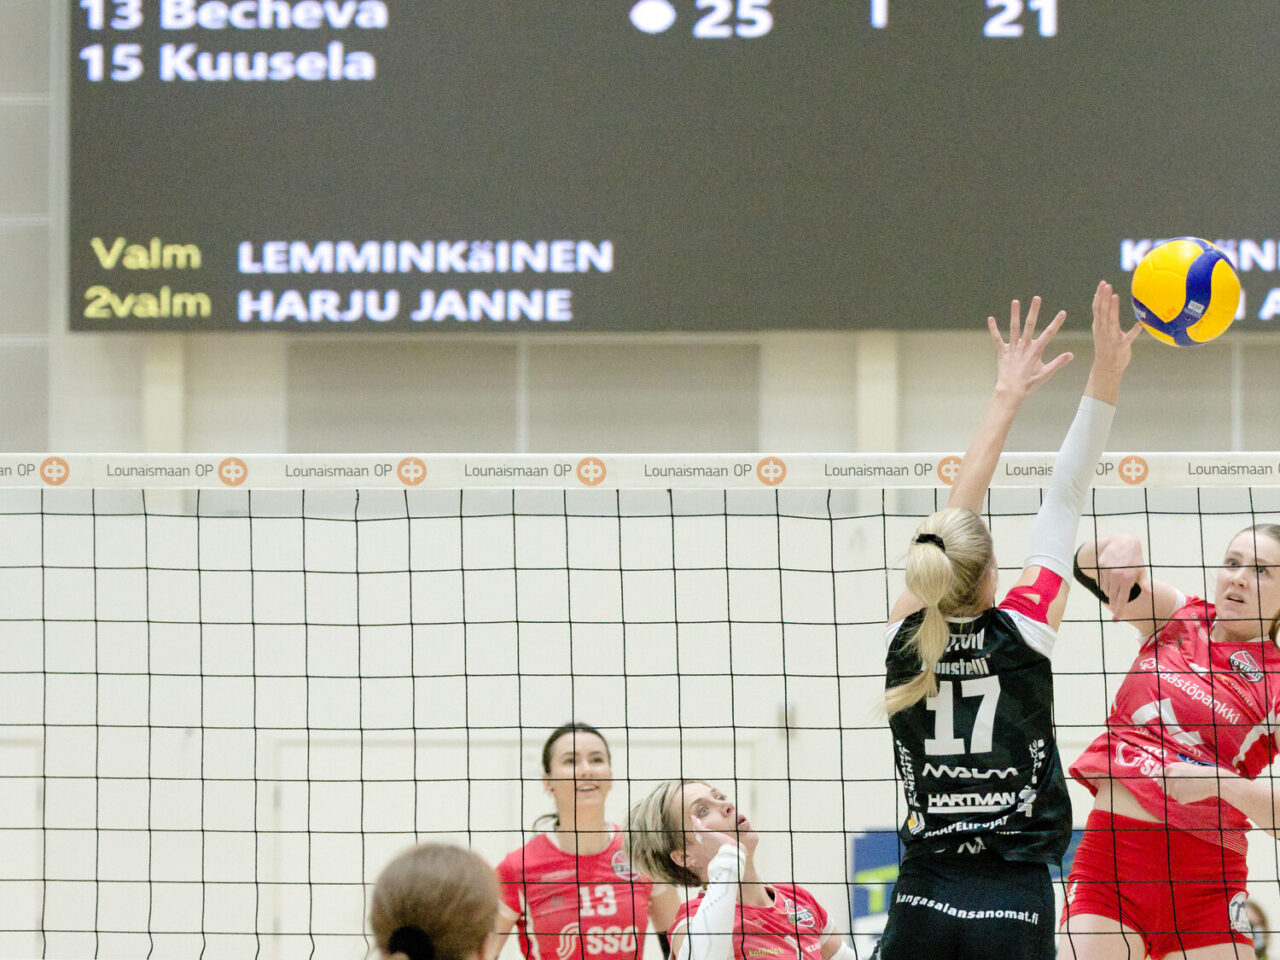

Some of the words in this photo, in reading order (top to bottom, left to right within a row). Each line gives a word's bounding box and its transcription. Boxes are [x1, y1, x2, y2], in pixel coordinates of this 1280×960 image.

[80, 0, 143, 30] 13
[161, 0, 388, 30] Becheva
[693, 0, 773, 38] 25
[983, 0, 1057, 37] 21
[80, 43, 143, 82] 15
[160, 41, 375, 82] Kuusela
[91, 237, 201, 270] Valm
[84, 286, 211, 319] 2valm
[238, 289, 399, 322] HARJU
[411, 289, 572, 322] JANNE
[17, 463, 36, 477] OP
[106, 463, 191, 477] Lounaismaan
[195, 463, 214, 477] OP
[285, 463, 370, 478] Lounaismaan
[373, 463, 393, 477] OP
[463, 463, 549, 477] Lounaismaan
[553, 463, 573, 477] OP
[643, 463, 729, 477] Lounaismaan
[733, 463, 753, 477] OP
[823, 463, 909, 477] Lounaismaan
[913, 462, 933, 477] OP
[1005, 463, 1054, 477] Lounais
[1187, 462, 1273, 476] Lounaismaan
[921, 657, 990, 676] uustelli
[924, 675, 1001, 756] 17
[927, 792, 1016, 808] HARTMAN
[579, 884, 617, 917] 13
